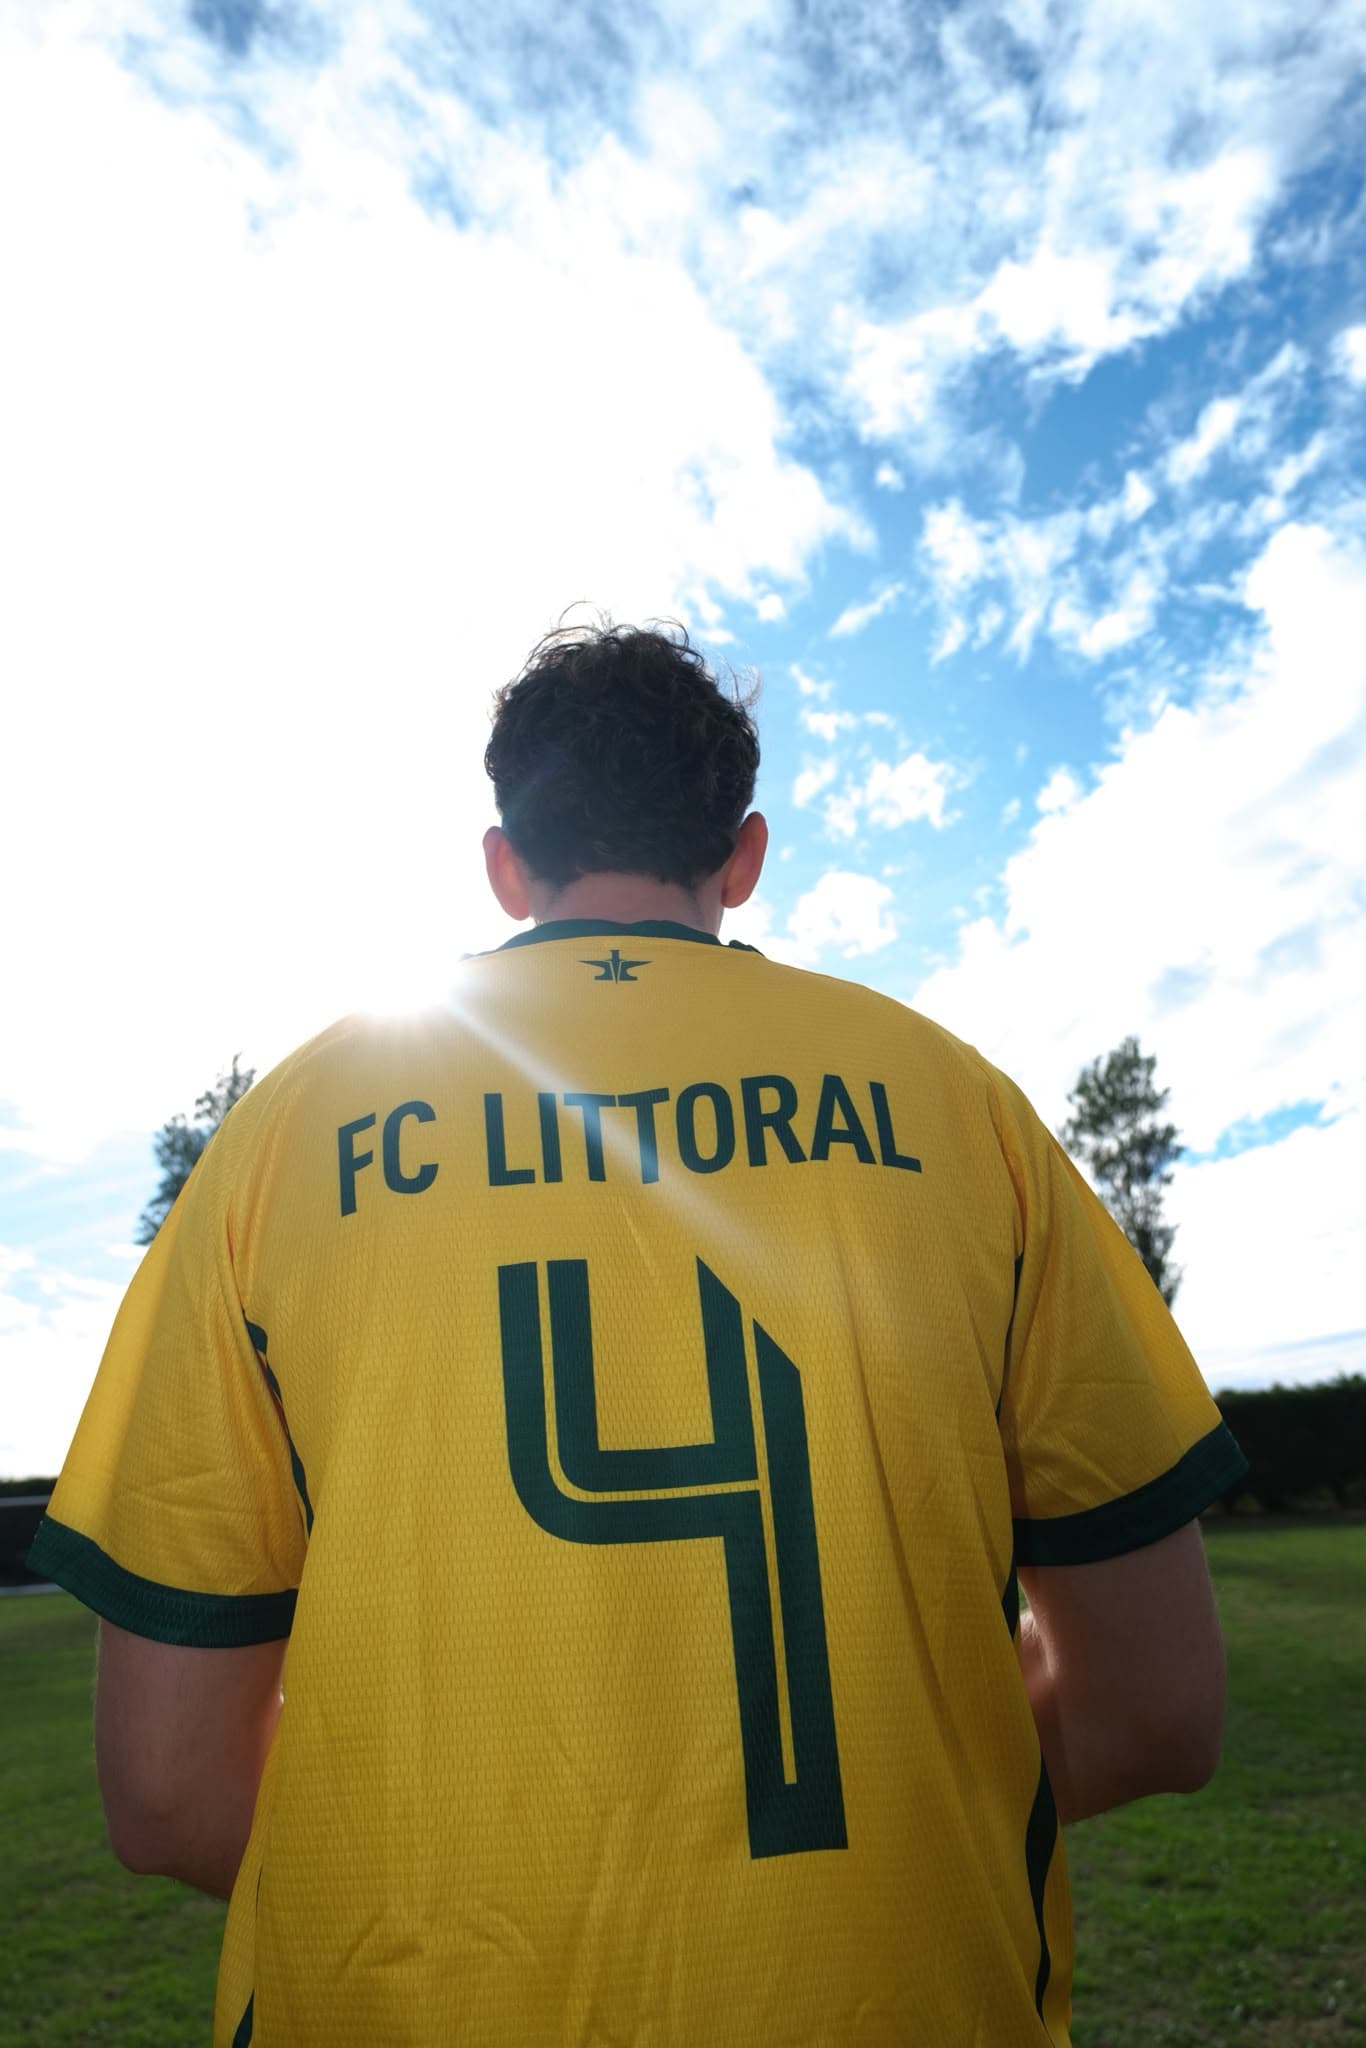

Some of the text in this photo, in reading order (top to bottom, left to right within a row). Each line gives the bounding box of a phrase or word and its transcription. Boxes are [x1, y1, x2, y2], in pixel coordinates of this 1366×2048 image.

[338, 1073, 922, 1217] FC LITTORAL
[498, 1256, 849, 1858] 4
